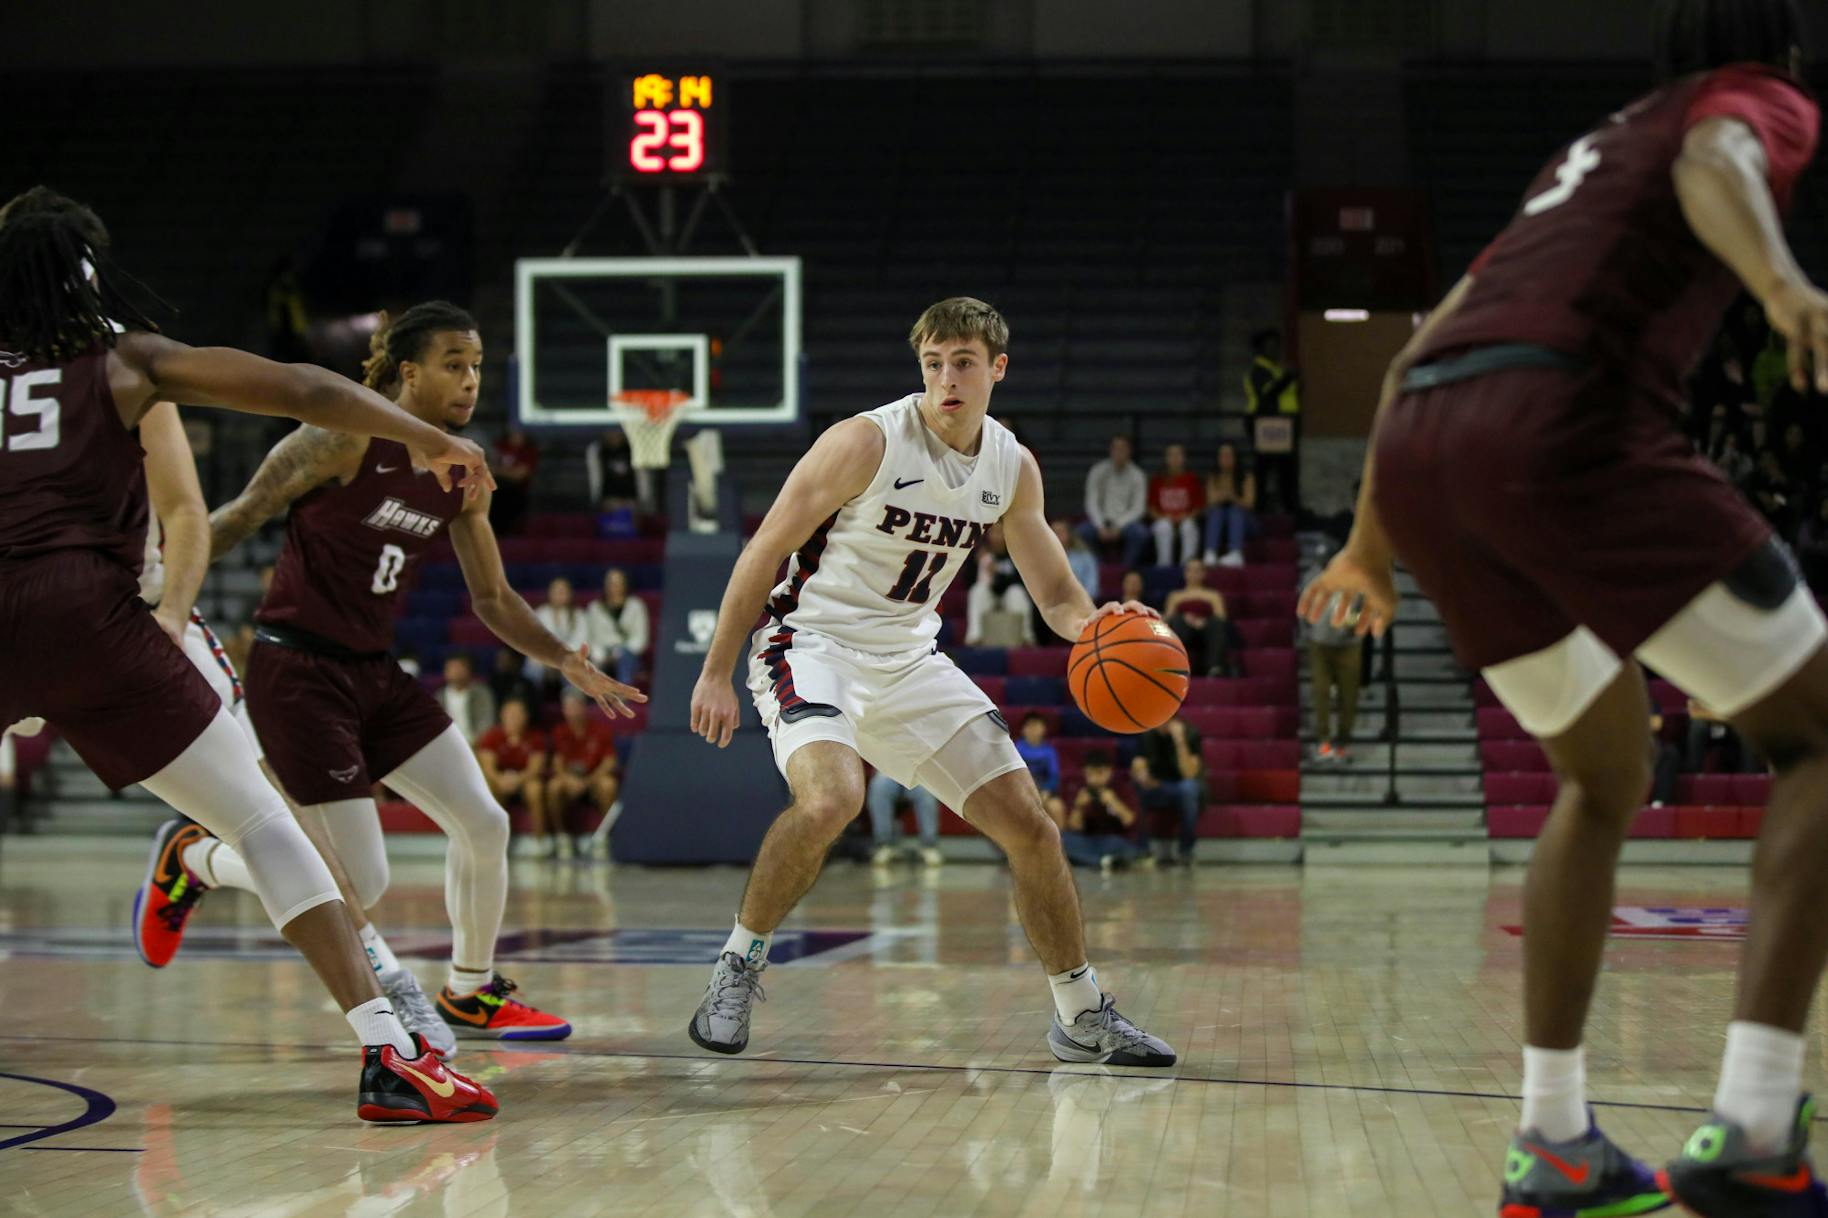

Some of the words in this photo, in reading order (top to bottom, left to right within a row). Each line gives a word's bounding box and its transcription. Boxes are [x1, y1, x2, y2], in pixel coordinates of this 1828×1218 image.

[630, 109, 704, 172] 23
[876, 504, 994, 549] PENN
[371, 543, 405, 594] 0
[886, 550, 948, 604] 11
